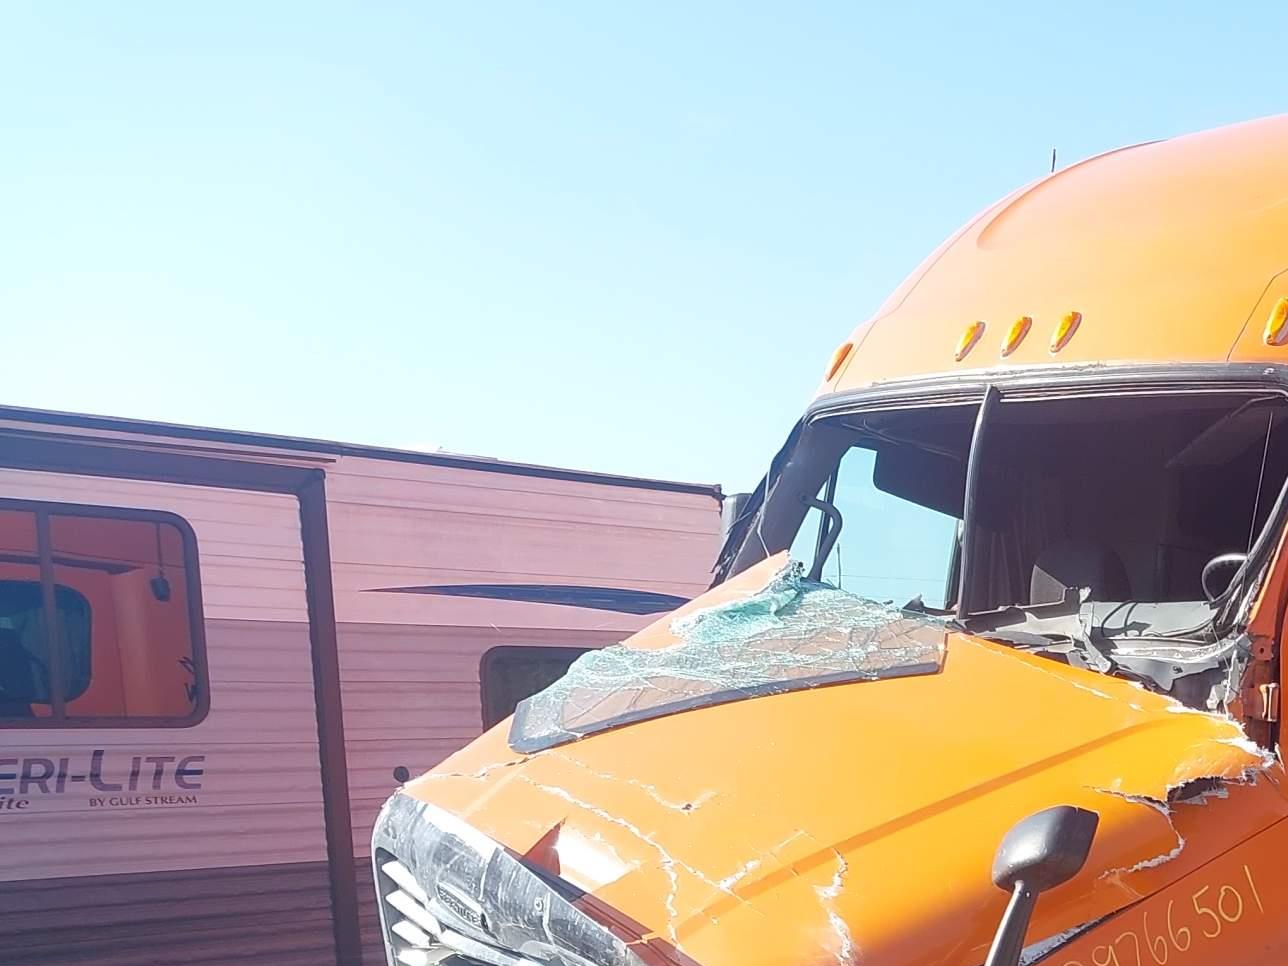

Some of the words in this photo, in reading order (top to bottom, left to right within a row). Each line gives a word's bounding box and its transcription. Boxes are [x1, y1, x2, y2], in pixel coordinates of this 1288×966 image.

[89, 798, 105, 807] BY
[109, 797, 142, 806] GULF
[145, 796, 197, 805] STREAM
